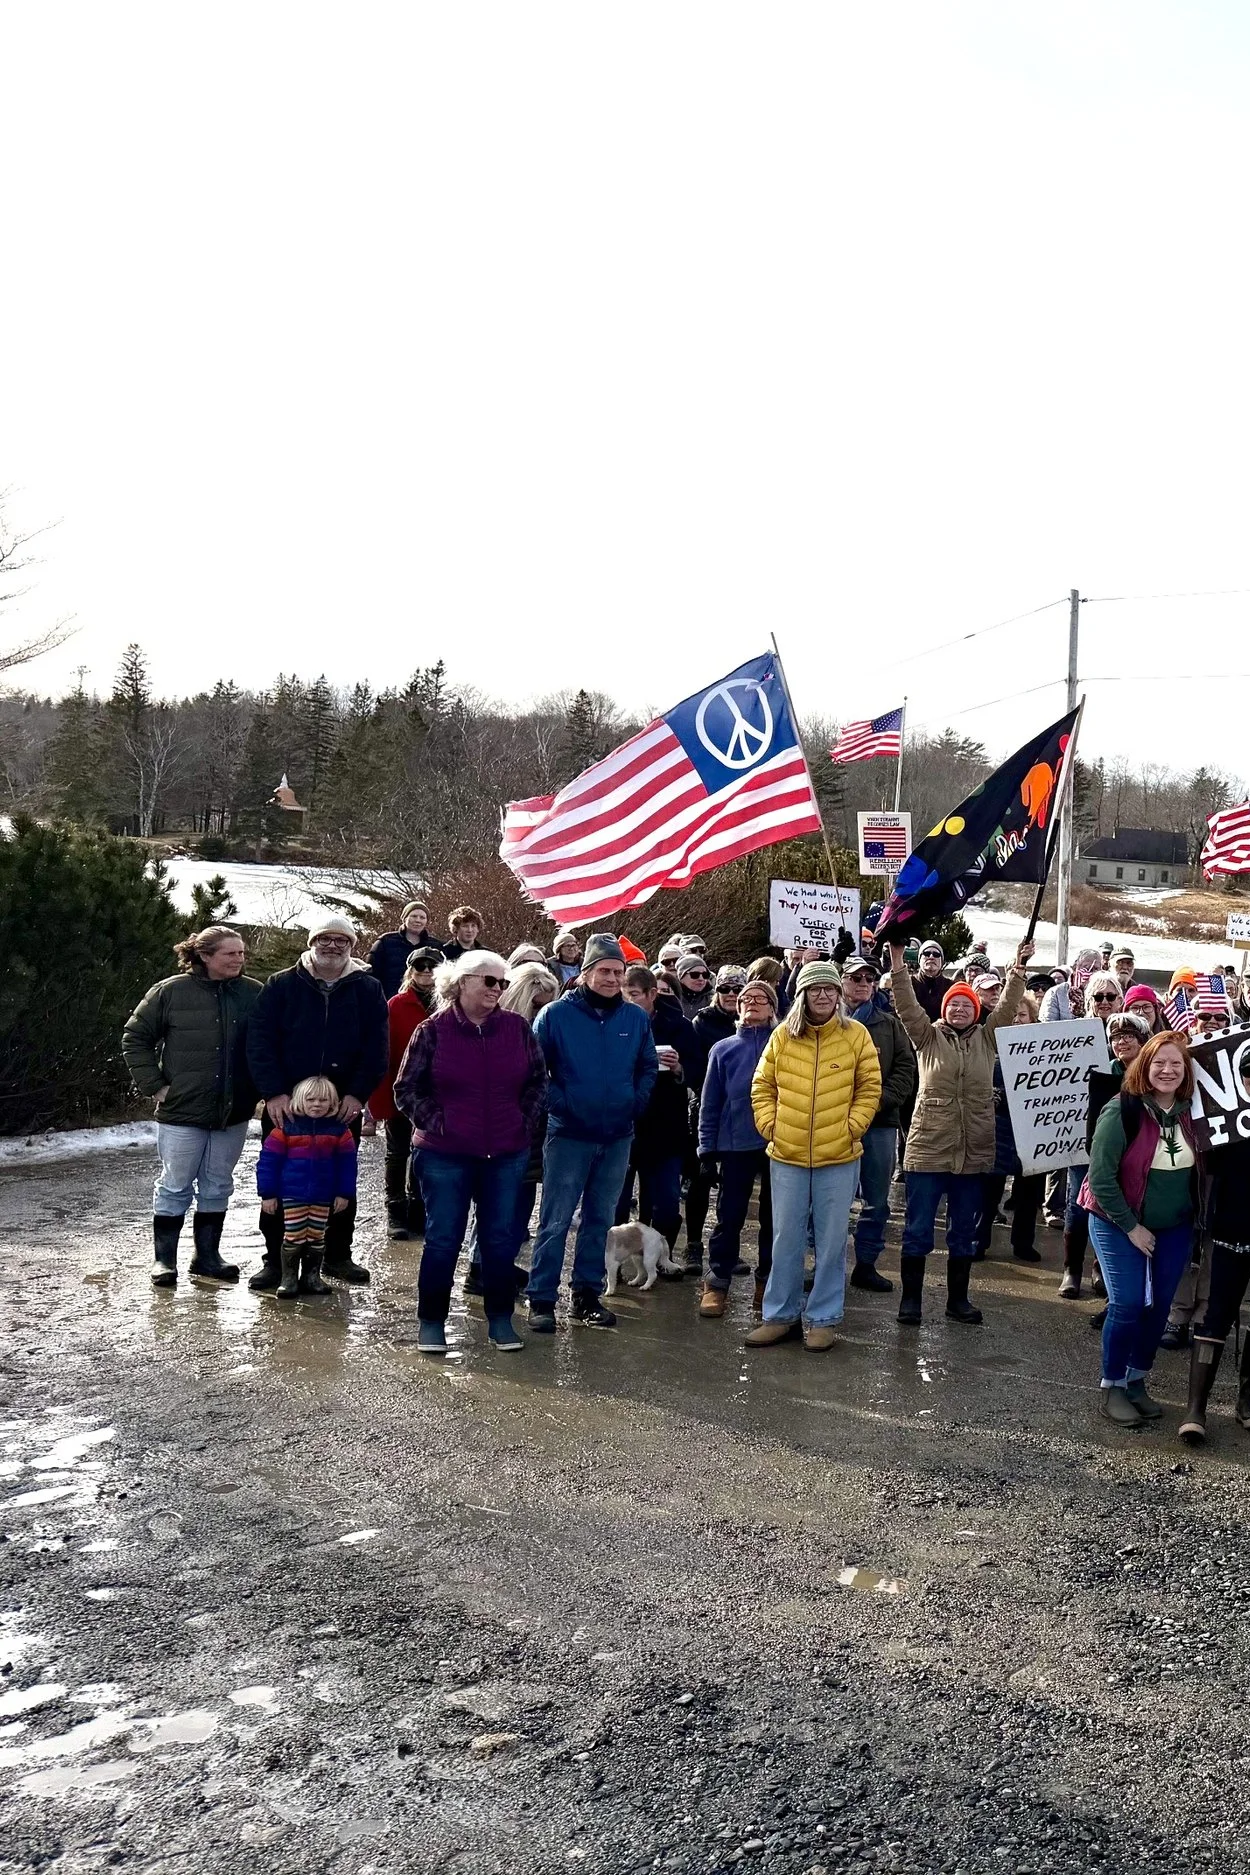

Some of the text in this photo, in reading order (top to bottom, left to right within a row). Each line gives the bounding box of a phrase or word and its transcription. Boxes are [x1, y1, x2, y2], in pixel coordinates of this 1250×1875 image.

[785, 887, 799, 897] We
[801, 888, 817, 897] had
[778, 899, 800, 915] They
[802, 900, 818, 910] had
[1231, 915, 1244, 924] We
[809, 929, 827, 938] FOR
[1008, 1035, 1095, 1056] THE POWER
[1028, 1052, 1074, 1066] OF THE
[1023, 1093, 1077, 1110] TRUMPS
[1055, 1125, 1074, 1138] IN
[1033, 1137, 1087, 1159] POWE
